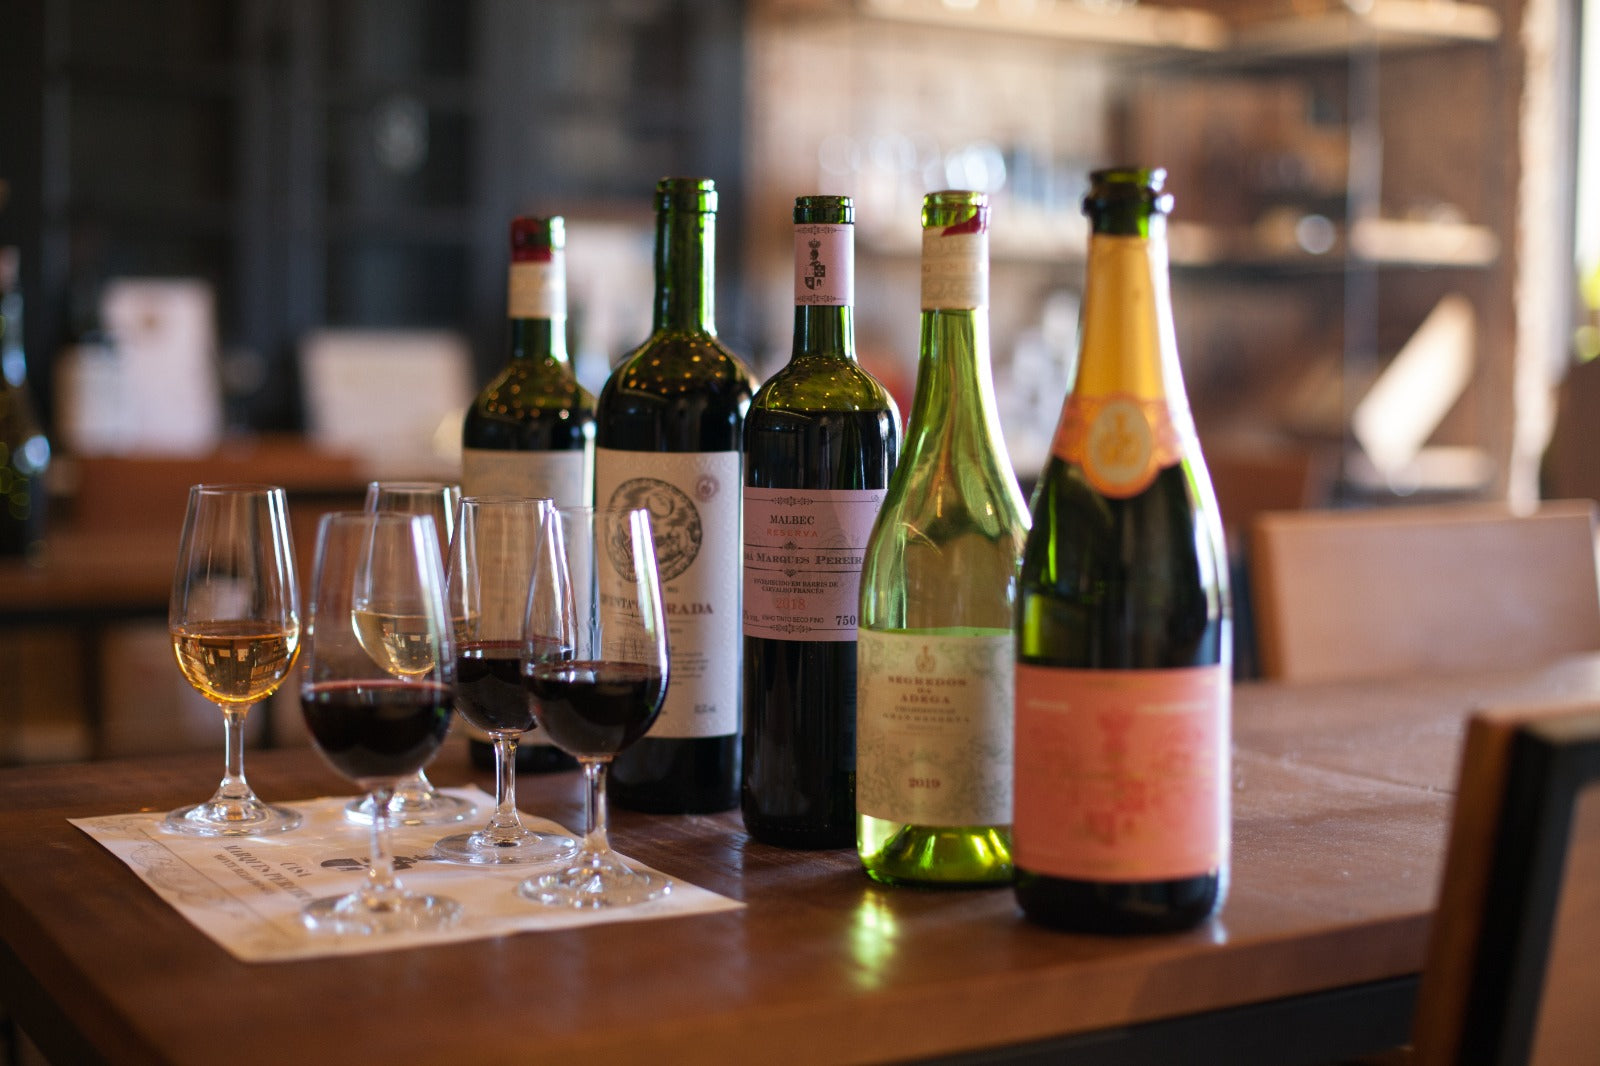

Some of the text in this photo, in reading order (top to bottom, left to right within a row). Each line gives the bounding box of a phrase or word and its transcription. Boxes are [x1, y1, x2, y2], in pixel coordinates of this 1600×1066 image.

[770, 515, 815, 525] MALBEC
[766, 529, 818, 538] RESERVA
[756, 553, 810, 565] MARQUES
[815, 555, 863, 565] PEREIR
[775, 598, 806, 611] 2018
[776, 615, 792, 623] TINTO
[809, 616, 825, 624] FINO
[835, 615, 857, 626] 750
[902, 694, 951, 704] ADEGA
[908, 777, 942, 789] 2019
